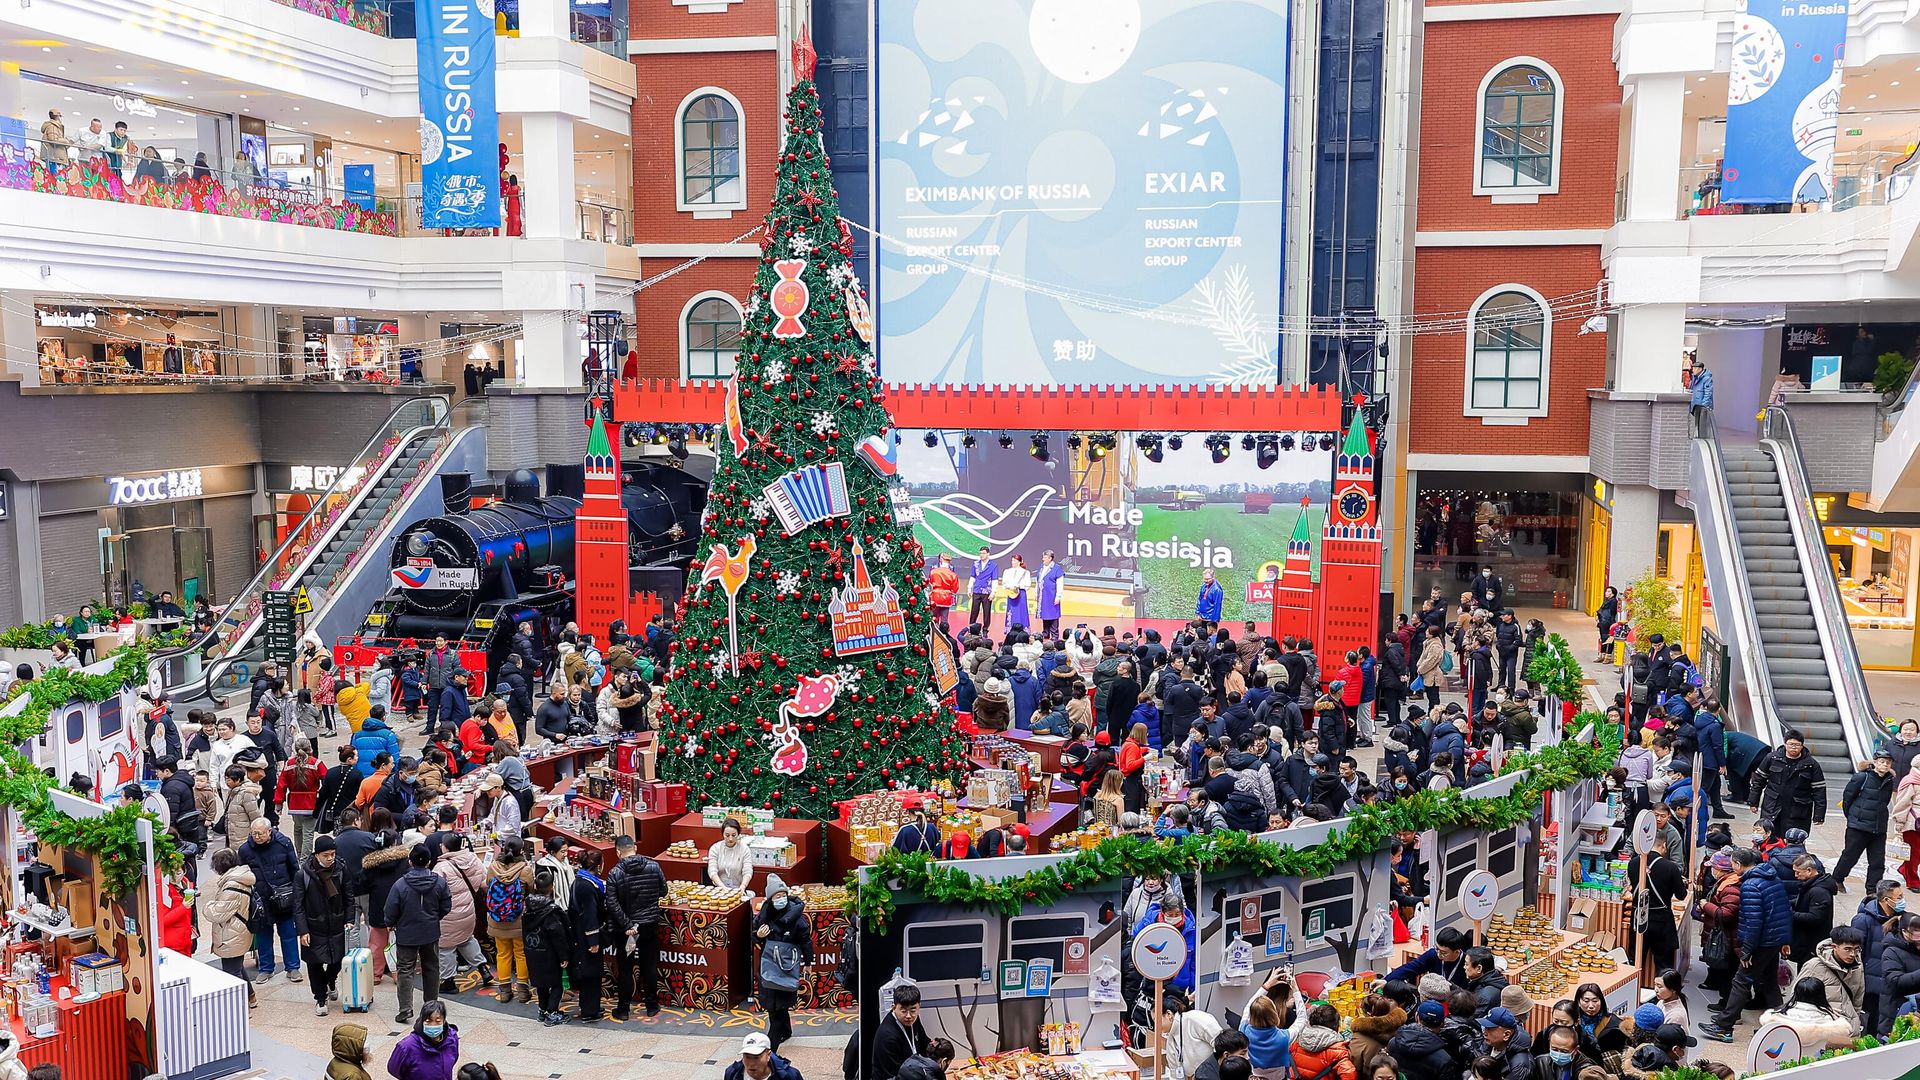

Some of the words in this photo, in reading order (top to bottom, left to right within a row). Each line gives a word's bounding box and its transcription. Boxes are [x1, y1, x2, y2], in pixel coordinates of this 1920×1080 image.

[1781, 5, 1795, 16] in
[1798, 3, 1846, 16] Russia
[441, 5, 469, 34] IN
[443, 46, 473, 163] RUSSIA
[1145, 172, 1226, 194] EXIAR
[905, 185, 996, 202] EXIMBANK
[1000, 185, 1023, 201] OF
[1027, 184, 1091, 200] RUSSIA
[1145, 219, 1198, 230] RUSSIAN
[906, 227, 957, 238] RUSSIAN
[1145, 237, 1192, 248] EXPORT
[1194, 236, 1242, 247] CENTER
[906, 245, 952, 257] EXPORT
[954, 245, 1000, 256] CENTER
[1144, 255, 1188, 266] GROUP
[906, 264, 949, 275] GROUP
[1053, 340, 1096, 361] 赞助
[1068, 501, 1143, 525] Made
[1067, 533, 1092, 557] in
[1102, 534, 1195, 559] Russia
[438, 570, 461, 578] Made
[449, 580, 478, 588] Russia
[659, 950, 708, 967] RUSSIA
[820, 952, 836, 965] IN
